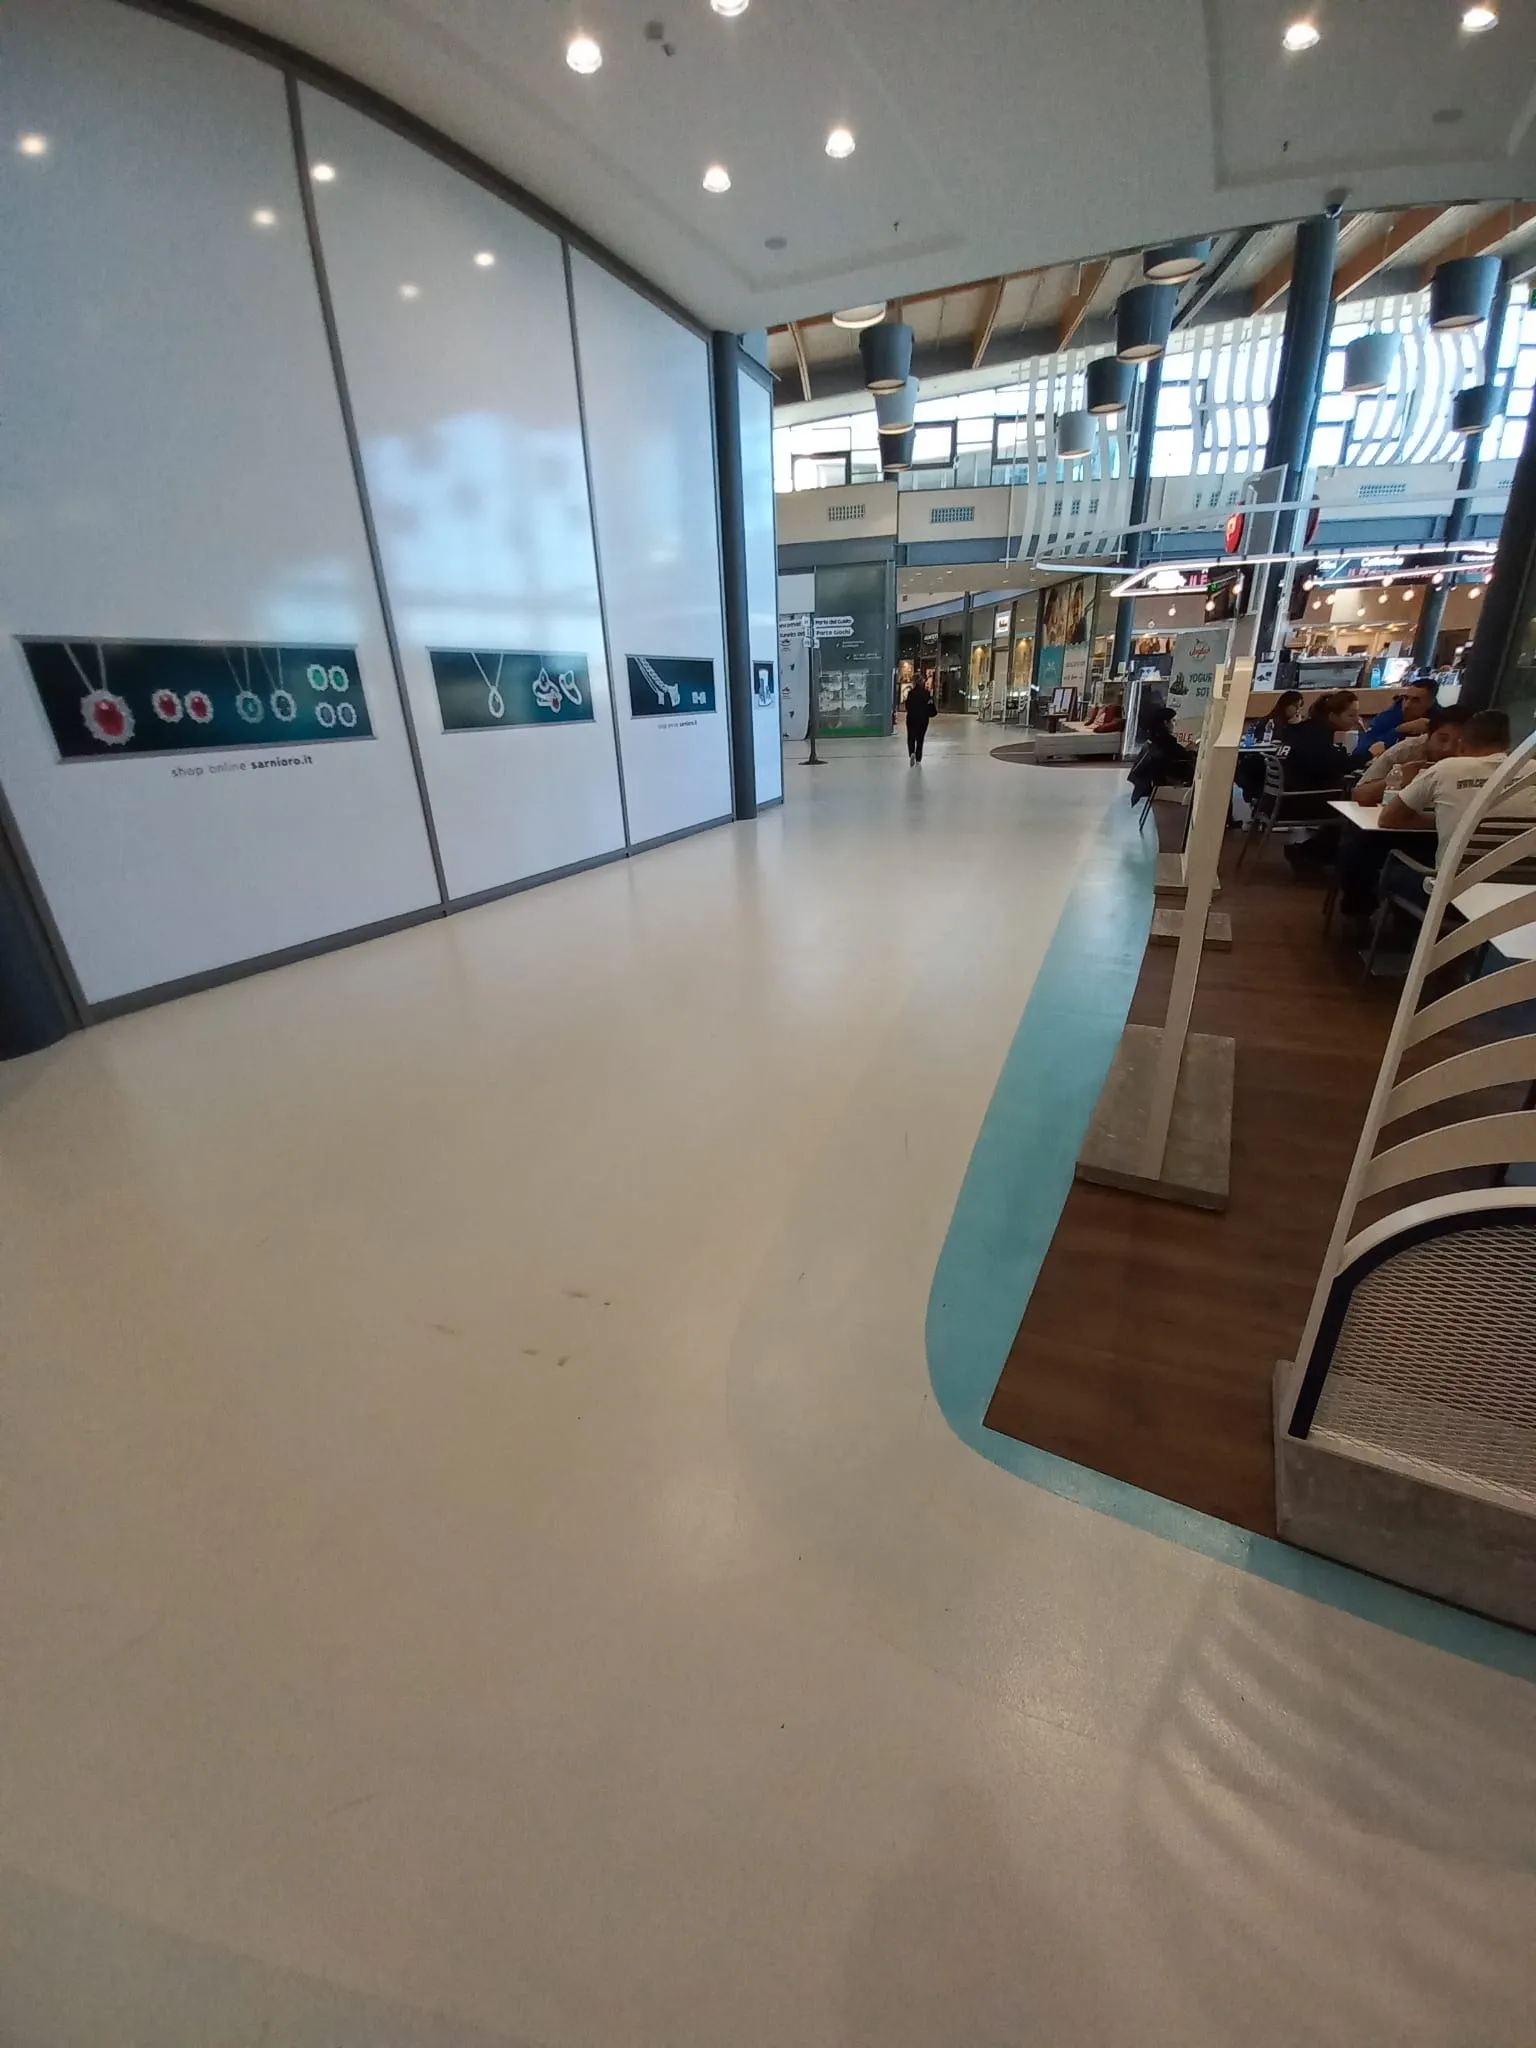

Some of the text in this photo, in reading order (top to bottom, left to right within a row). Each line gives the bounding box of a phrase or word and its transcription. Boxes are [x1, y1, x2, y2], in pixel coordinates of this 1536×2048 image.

[171, 754, 314, 778] shop online sarnioro.it
